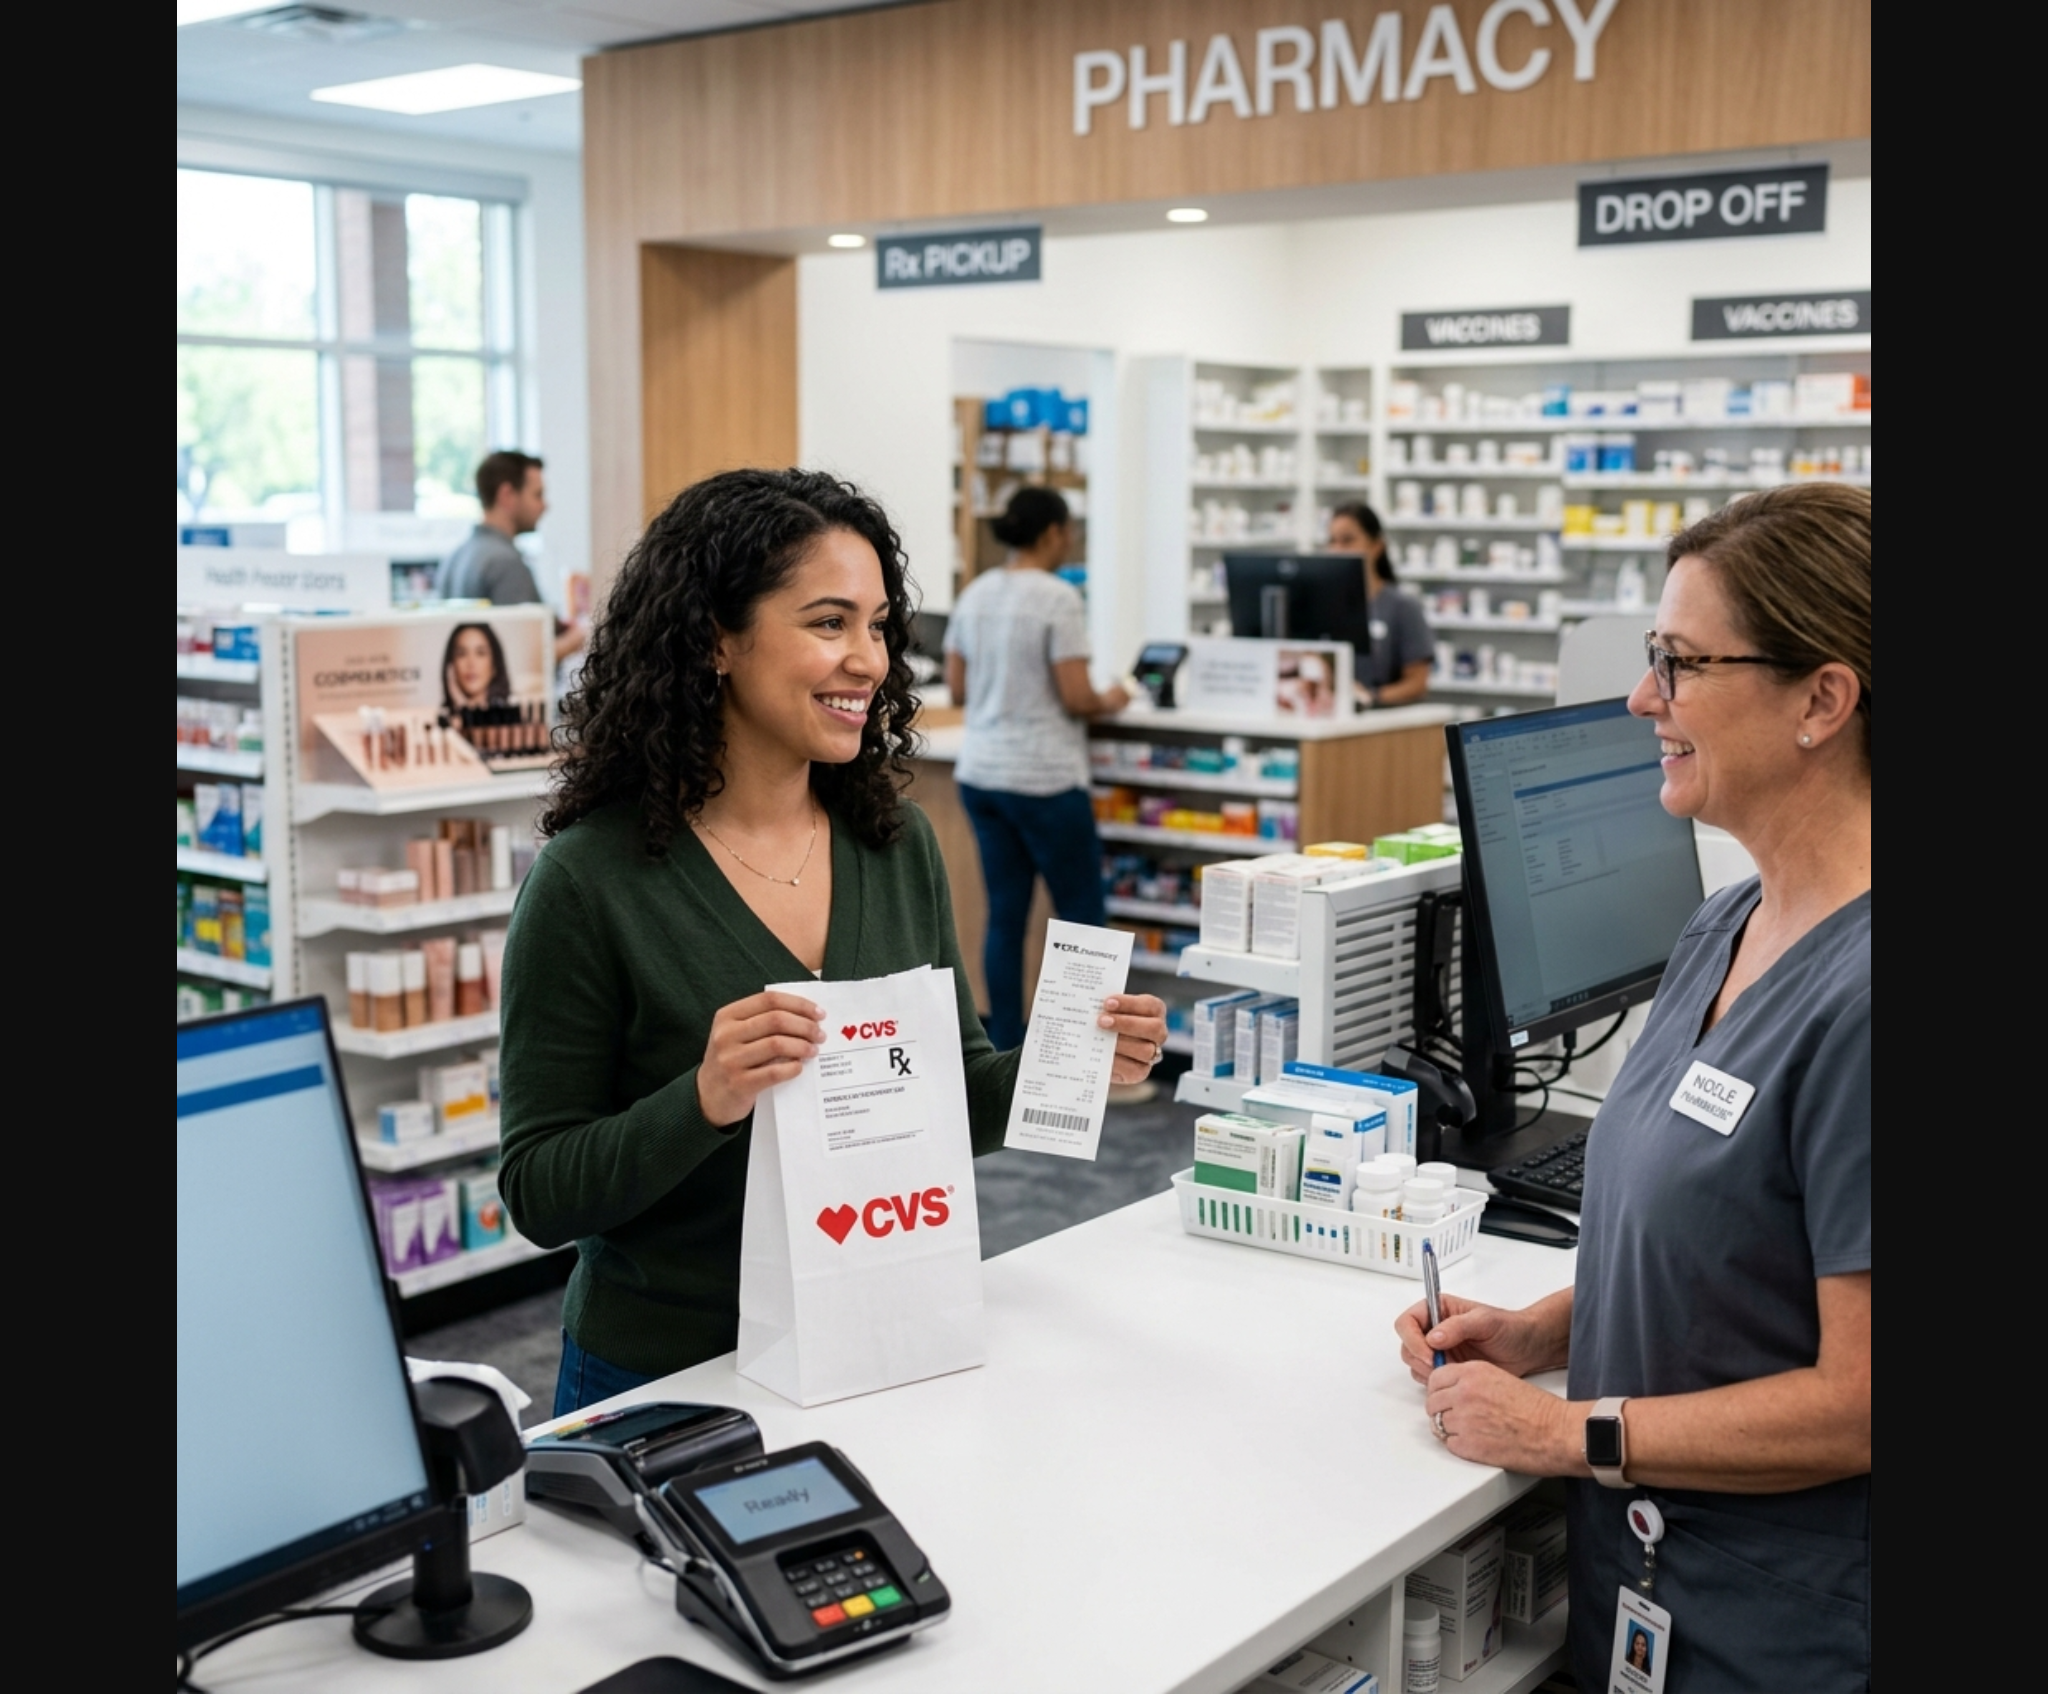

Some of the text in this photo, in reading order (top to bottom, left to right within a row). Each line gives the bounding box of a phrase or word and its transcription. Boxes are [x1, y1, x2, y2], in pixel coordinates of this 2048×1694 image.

[1073, 0, 1620, 136] PHARMACY
[1596, 181, 1807, 234] DROP OFF
[924, 238, 1031, 278] PICKUP
